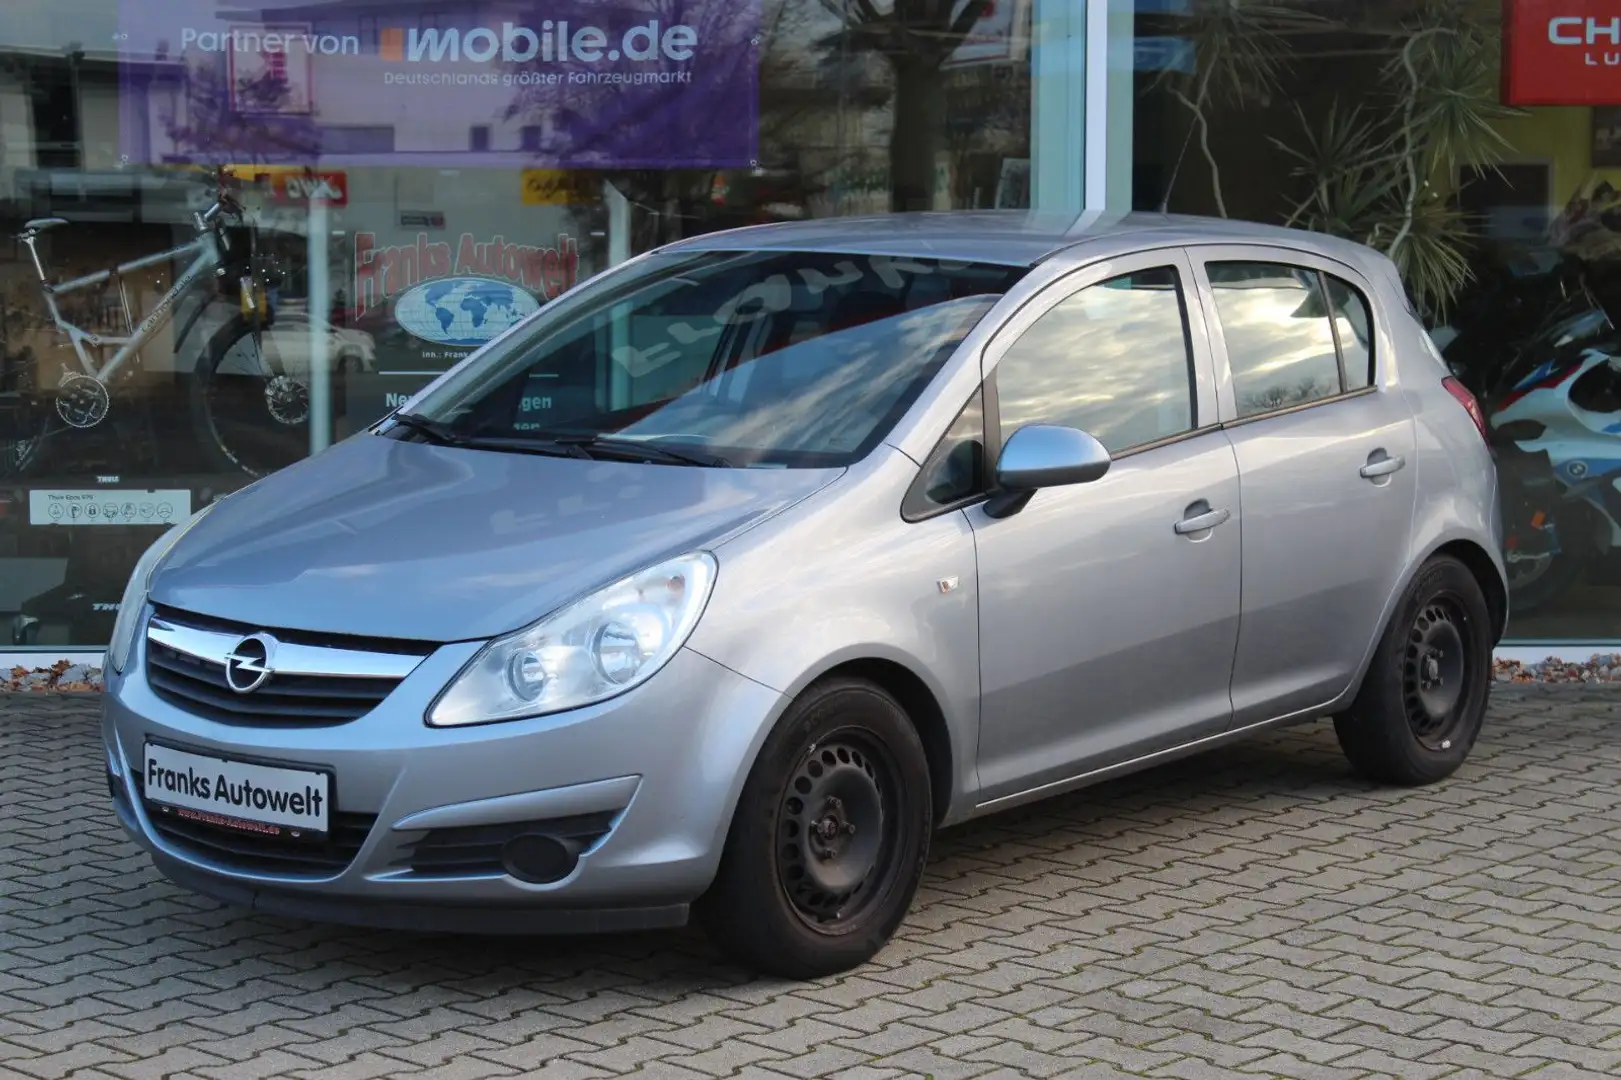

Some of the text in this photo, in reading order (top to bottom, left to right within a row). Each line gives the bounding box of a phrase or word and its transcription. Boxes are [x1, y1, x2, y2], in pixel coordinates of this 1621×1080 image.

[180, 20, 698, 62] Partner von mobile.de
[1548, 16, 1620, 45] CH
[1584, 52, 1620, 66] LU
[383, 70, 693, 87] Deutschlands größter Fahrzeugmarkt
[354, 232, 580, 322] Franks Autowelt
[386, 392, 552, 412] Ne gen
[147, 758, 324, 818] Franks Autowelt
